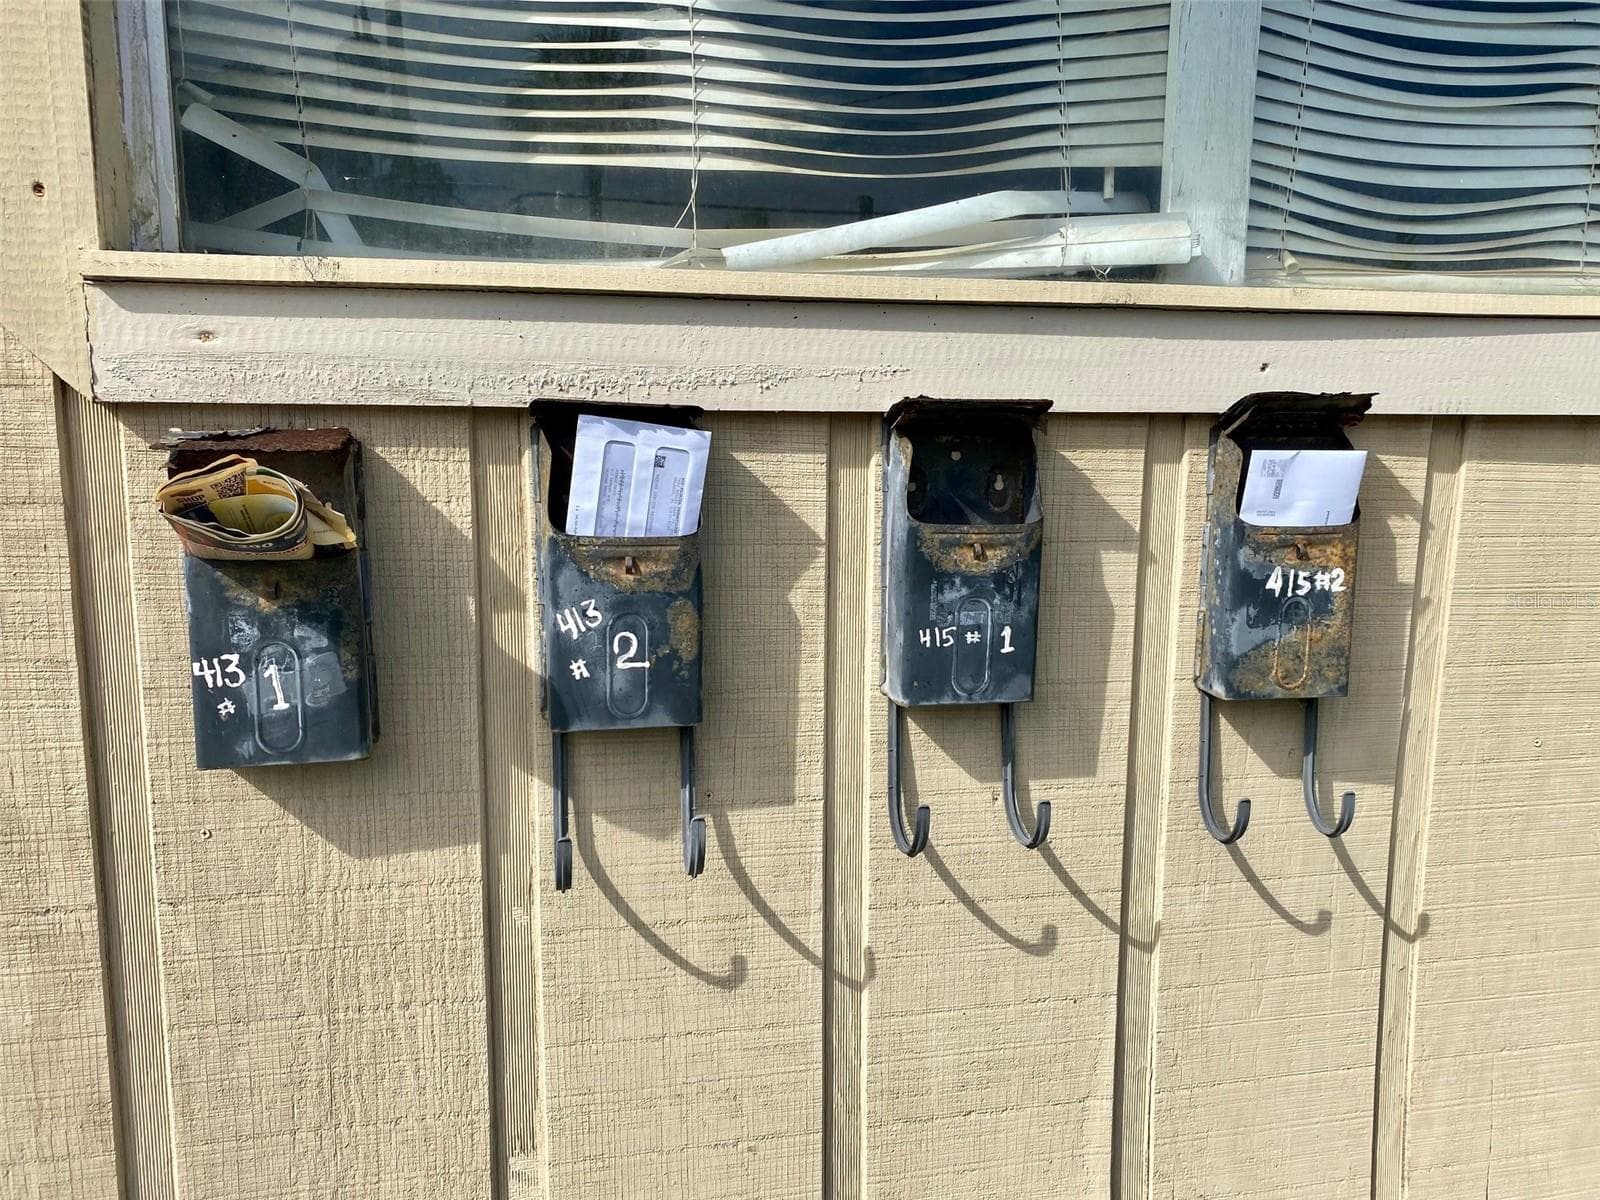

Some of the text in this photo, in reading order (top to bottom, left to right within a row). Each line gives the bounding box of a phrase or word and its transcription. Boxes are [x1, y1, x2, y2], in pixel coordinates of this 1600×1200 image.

[555, 599, 603, 640] 413
[613, 631, 651, 669] 2
[919, 626, 957, 648] 415
[1000, 625, 1016, 654] 1
[192, 653, 246, 688] 413
[263, 663, 290, 711] 1
